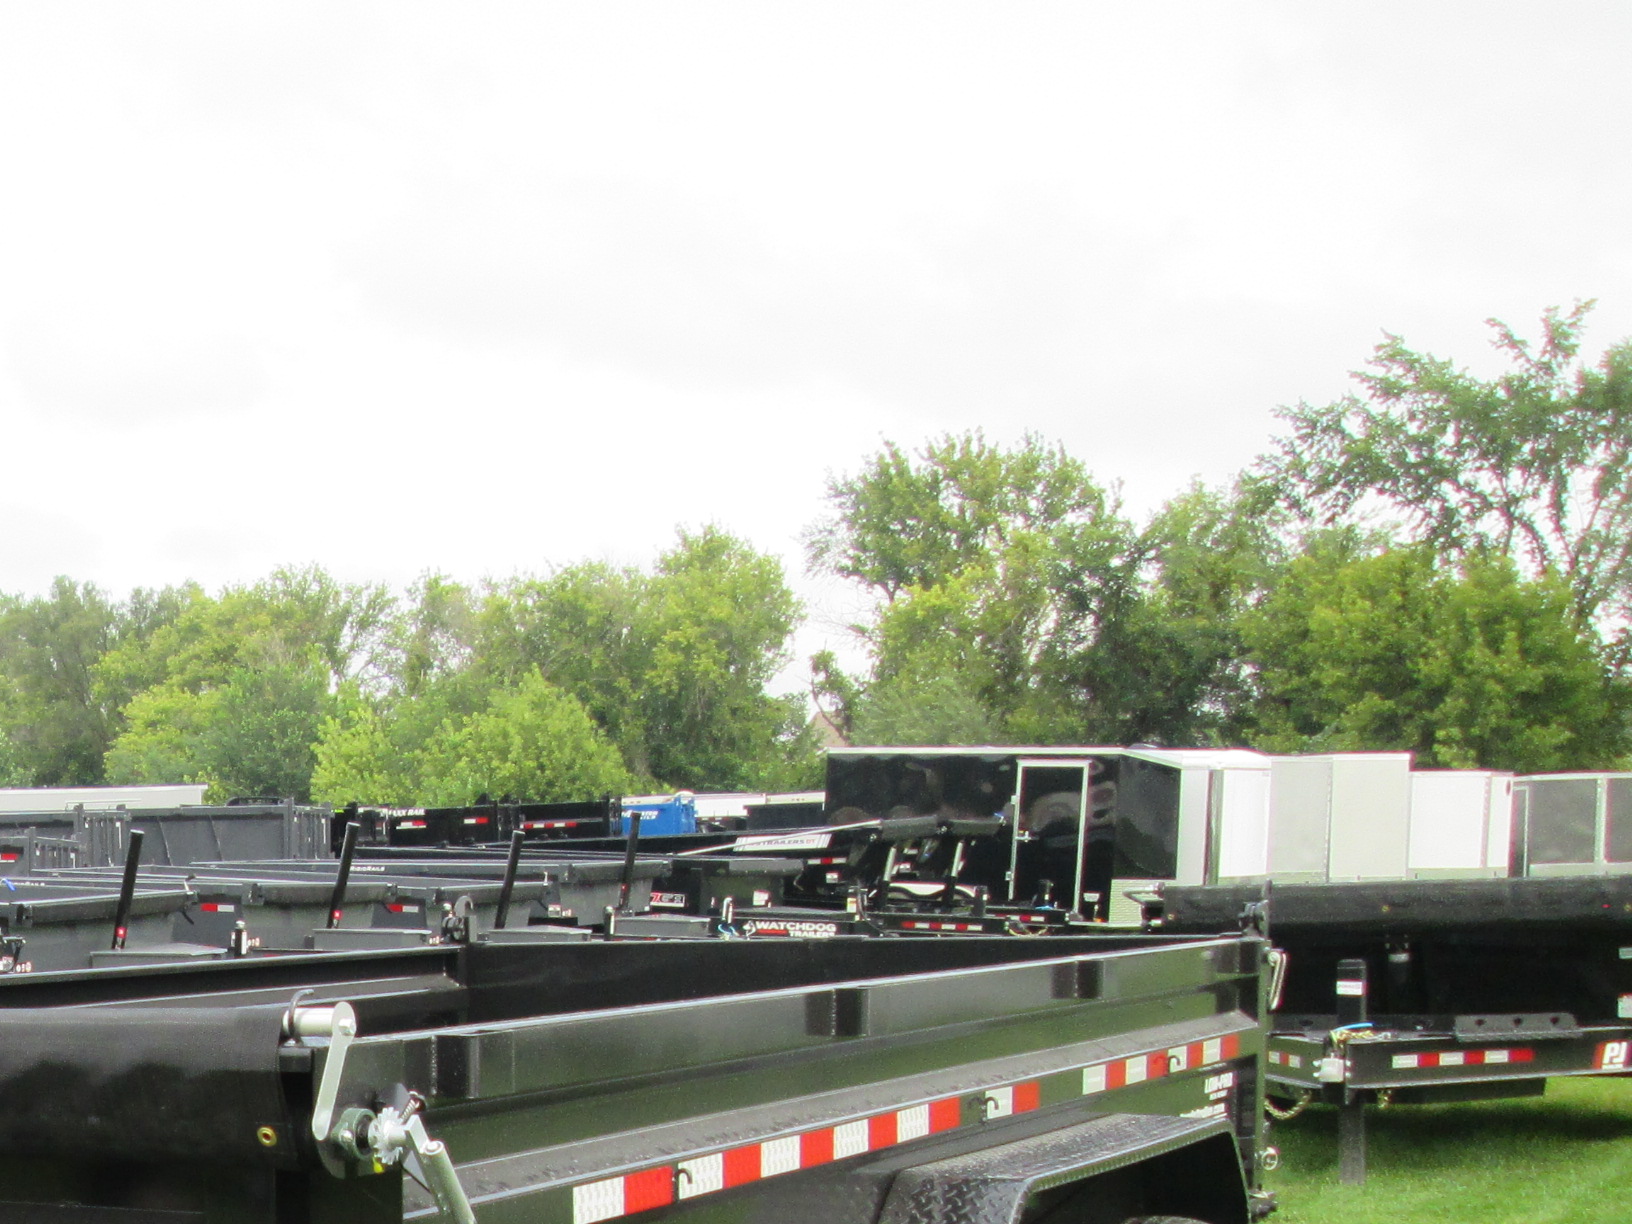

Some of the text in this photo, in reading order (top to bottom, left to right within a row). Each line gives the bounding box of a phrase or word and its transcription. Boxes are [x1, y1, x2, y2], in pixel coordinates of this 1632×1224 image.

[755, 920, 837, 932] WATCHDOG
[788, 930, 835, 938] TRAILERS
[1601, 1041, 1628, 1064] PJ
